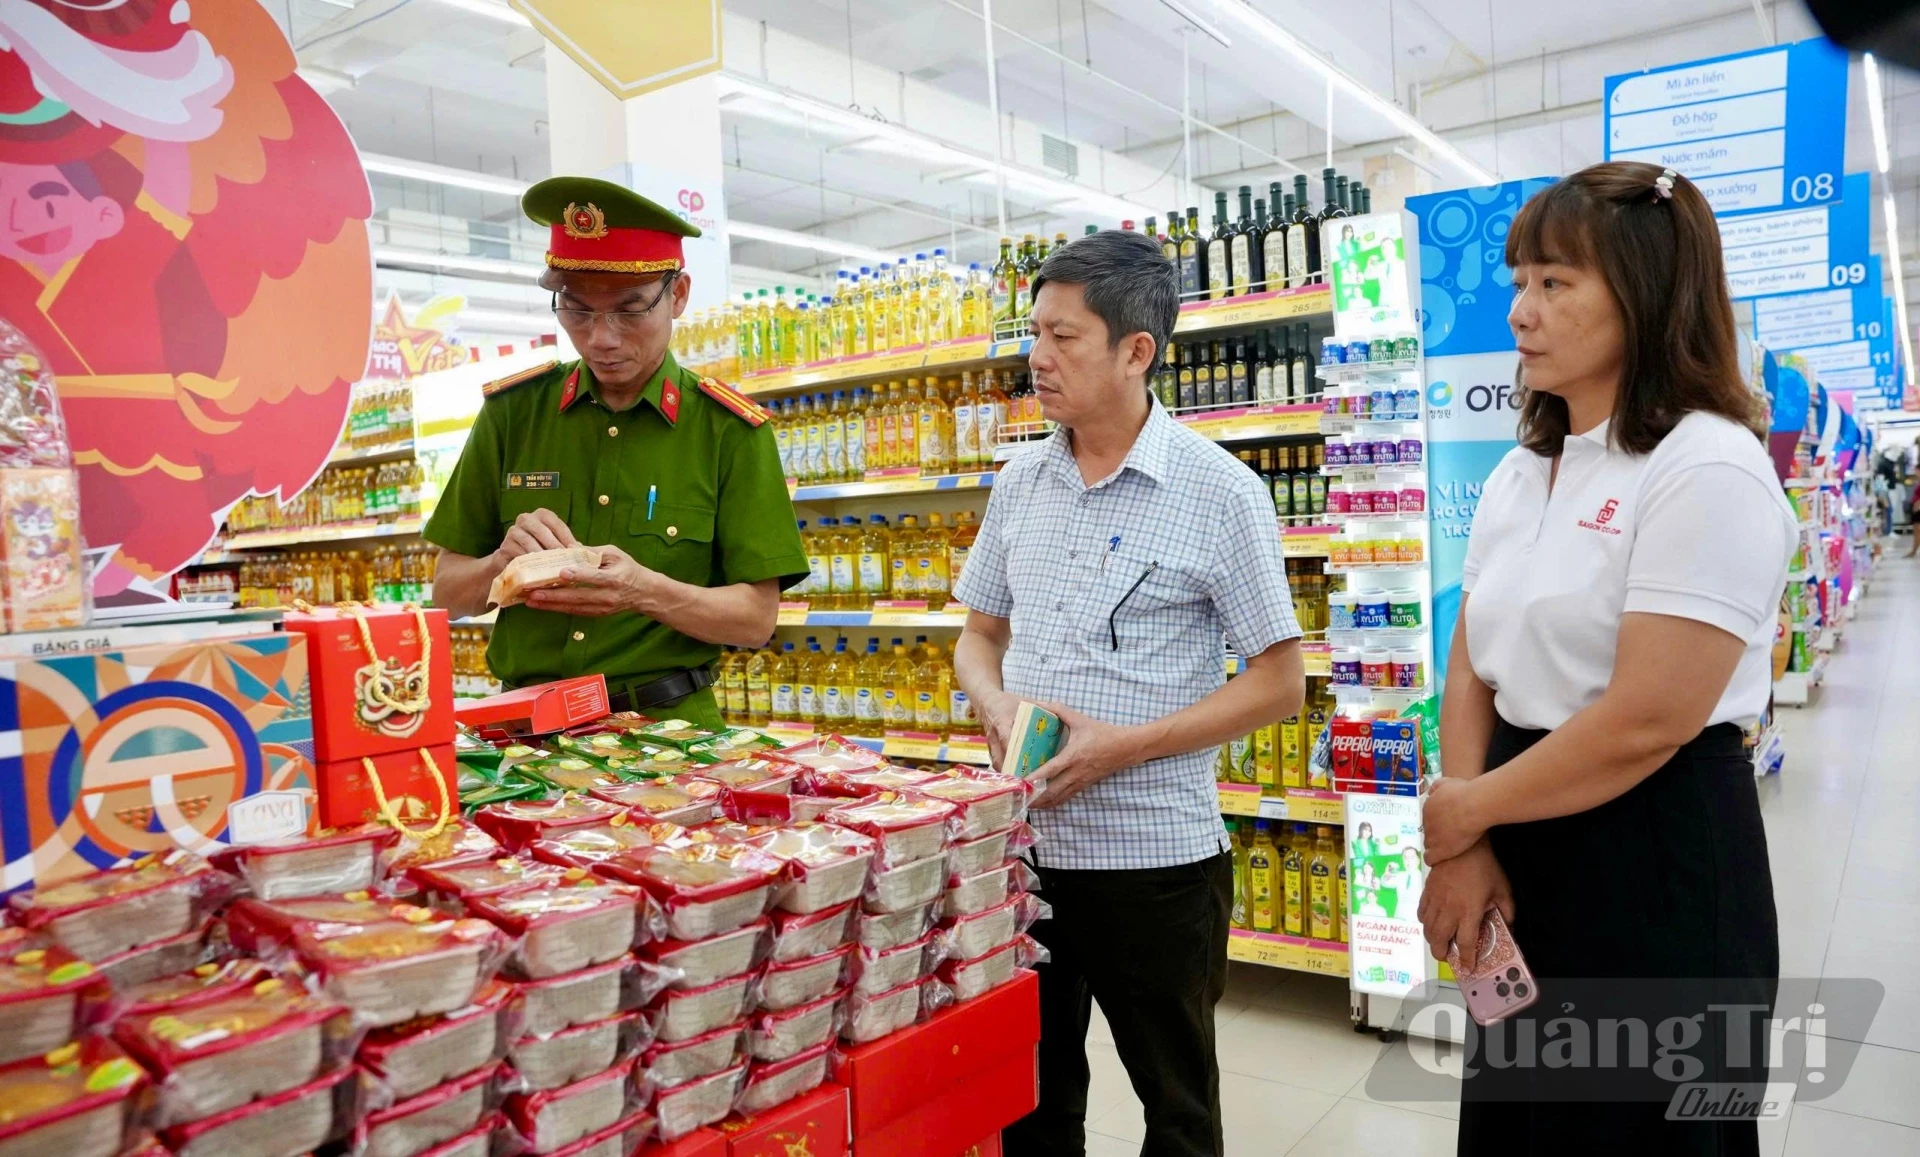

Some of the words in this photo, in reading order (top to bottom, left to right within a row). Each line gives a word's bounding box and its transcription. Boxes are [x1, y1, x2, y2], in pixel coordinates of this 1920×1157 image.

[1791, 172, 1834, 204] 08
[1831, 262, 1867, 286] 09
[1856, 321, 1882, 339] 10
[1872, 350, 1891, 366] 11
[1435, 478, 1460, 504] VỊ
[1465, 481, 1481, 499] N
[1577, 519, 1601, 532] SAIGON
[1361, 614, 1388, 623] XYLITOL
[83, 634, 112, 651] GIÁ
[1332, 670, 1358, 680] XYLITOL
[1332, 735, 1374, 752] PEPERO
[1372, 738, 1414, 756] PEPERO
[1313, 809, 1328, 819] 114
[1257, 950, 1268, 960] 72
[1306, 959, 1322, 969] 114
